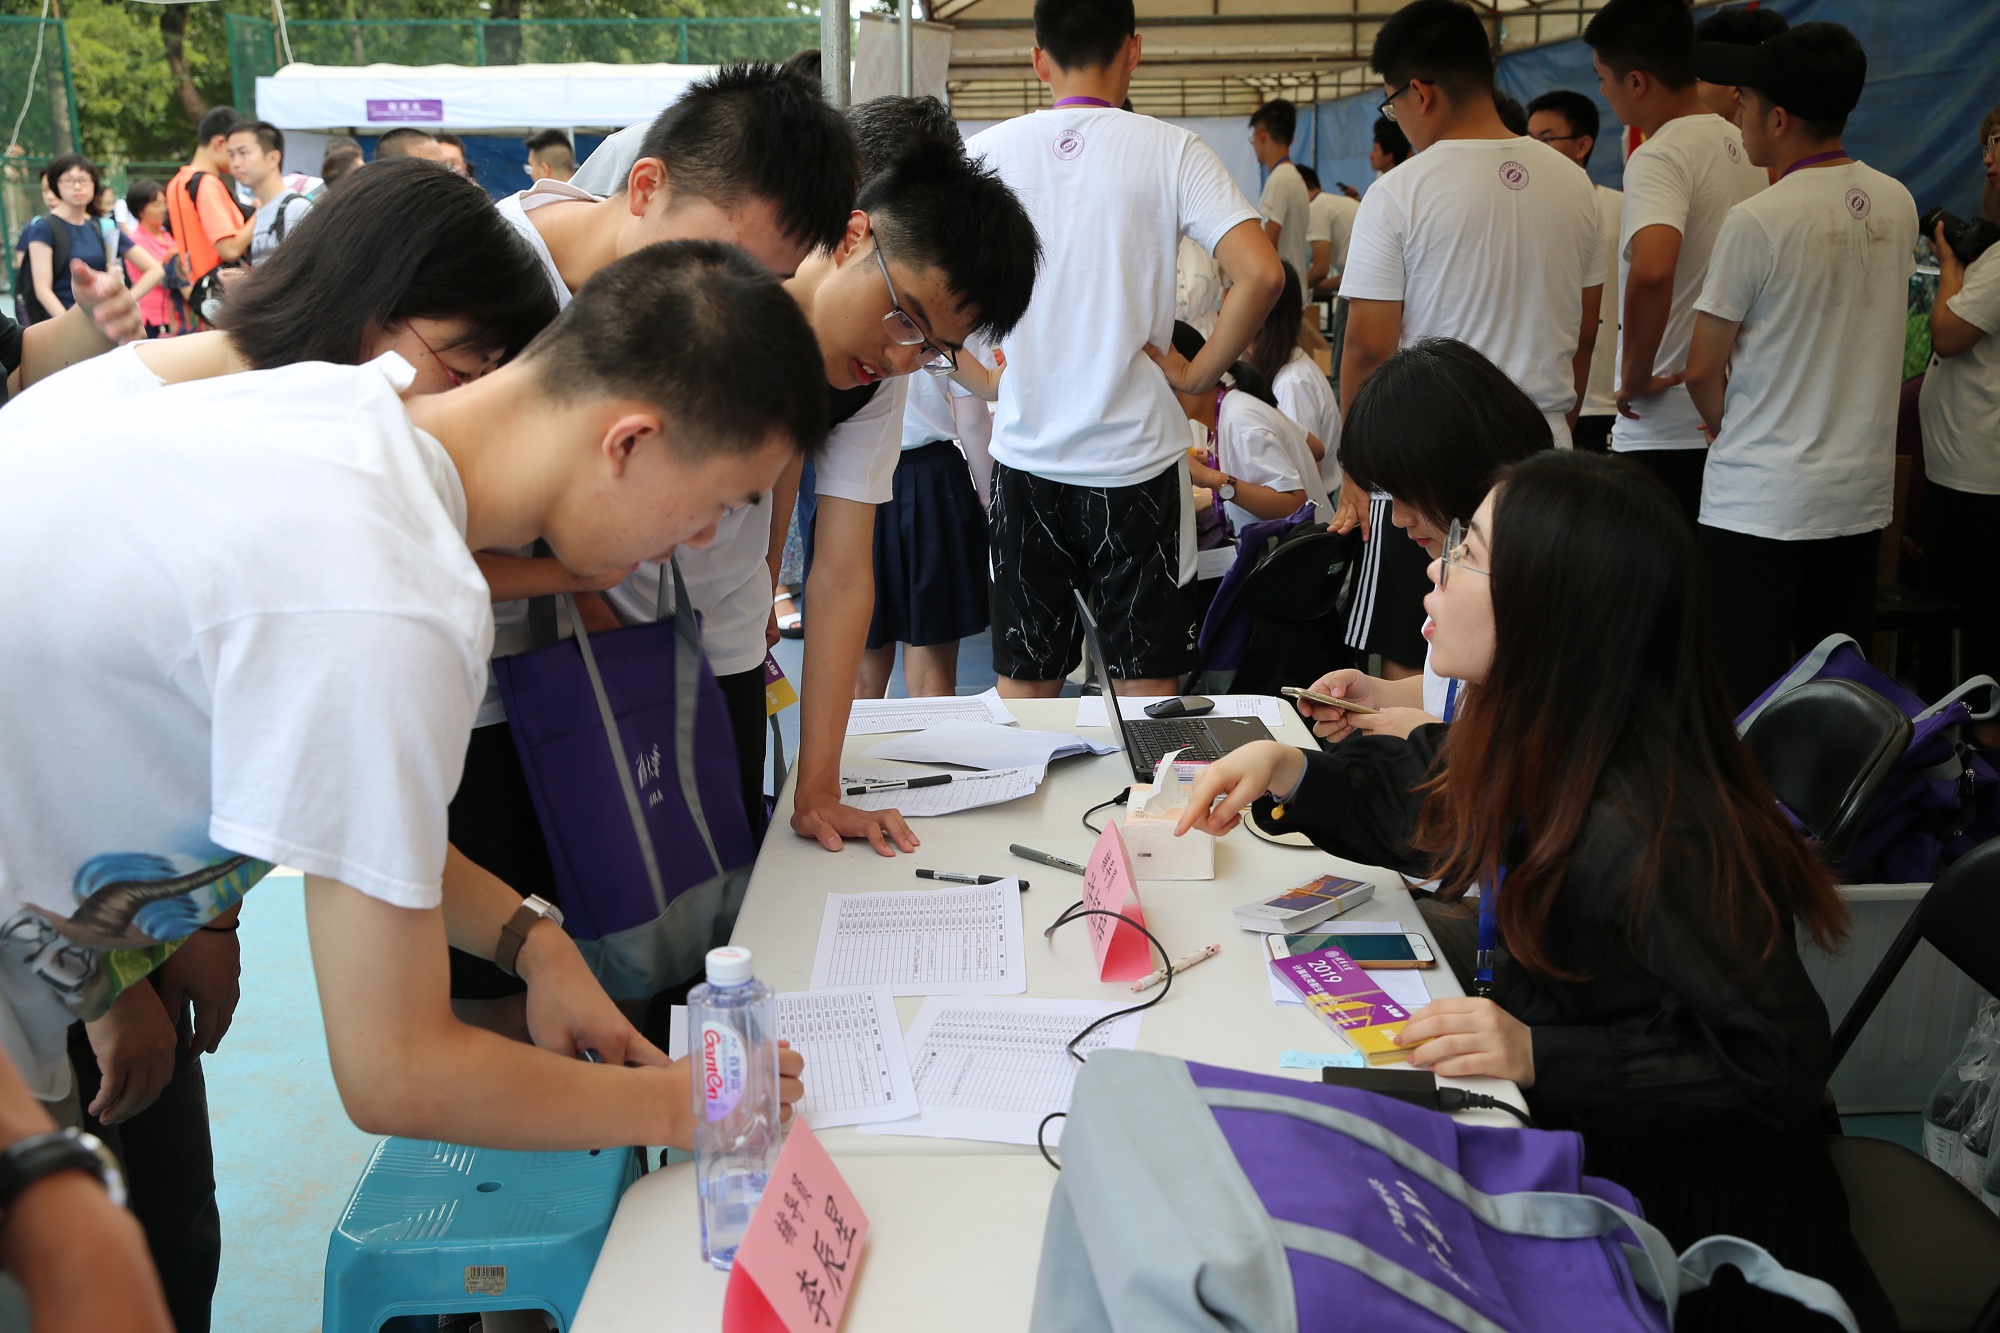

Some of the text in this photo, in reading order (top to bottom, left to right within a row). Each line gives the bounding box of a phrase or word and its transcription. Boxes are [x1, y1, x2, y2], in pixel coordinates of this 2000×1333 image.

[1307, 959, 1343, 983] 2019
[796, 1194, 857, 1327] 李辰星
